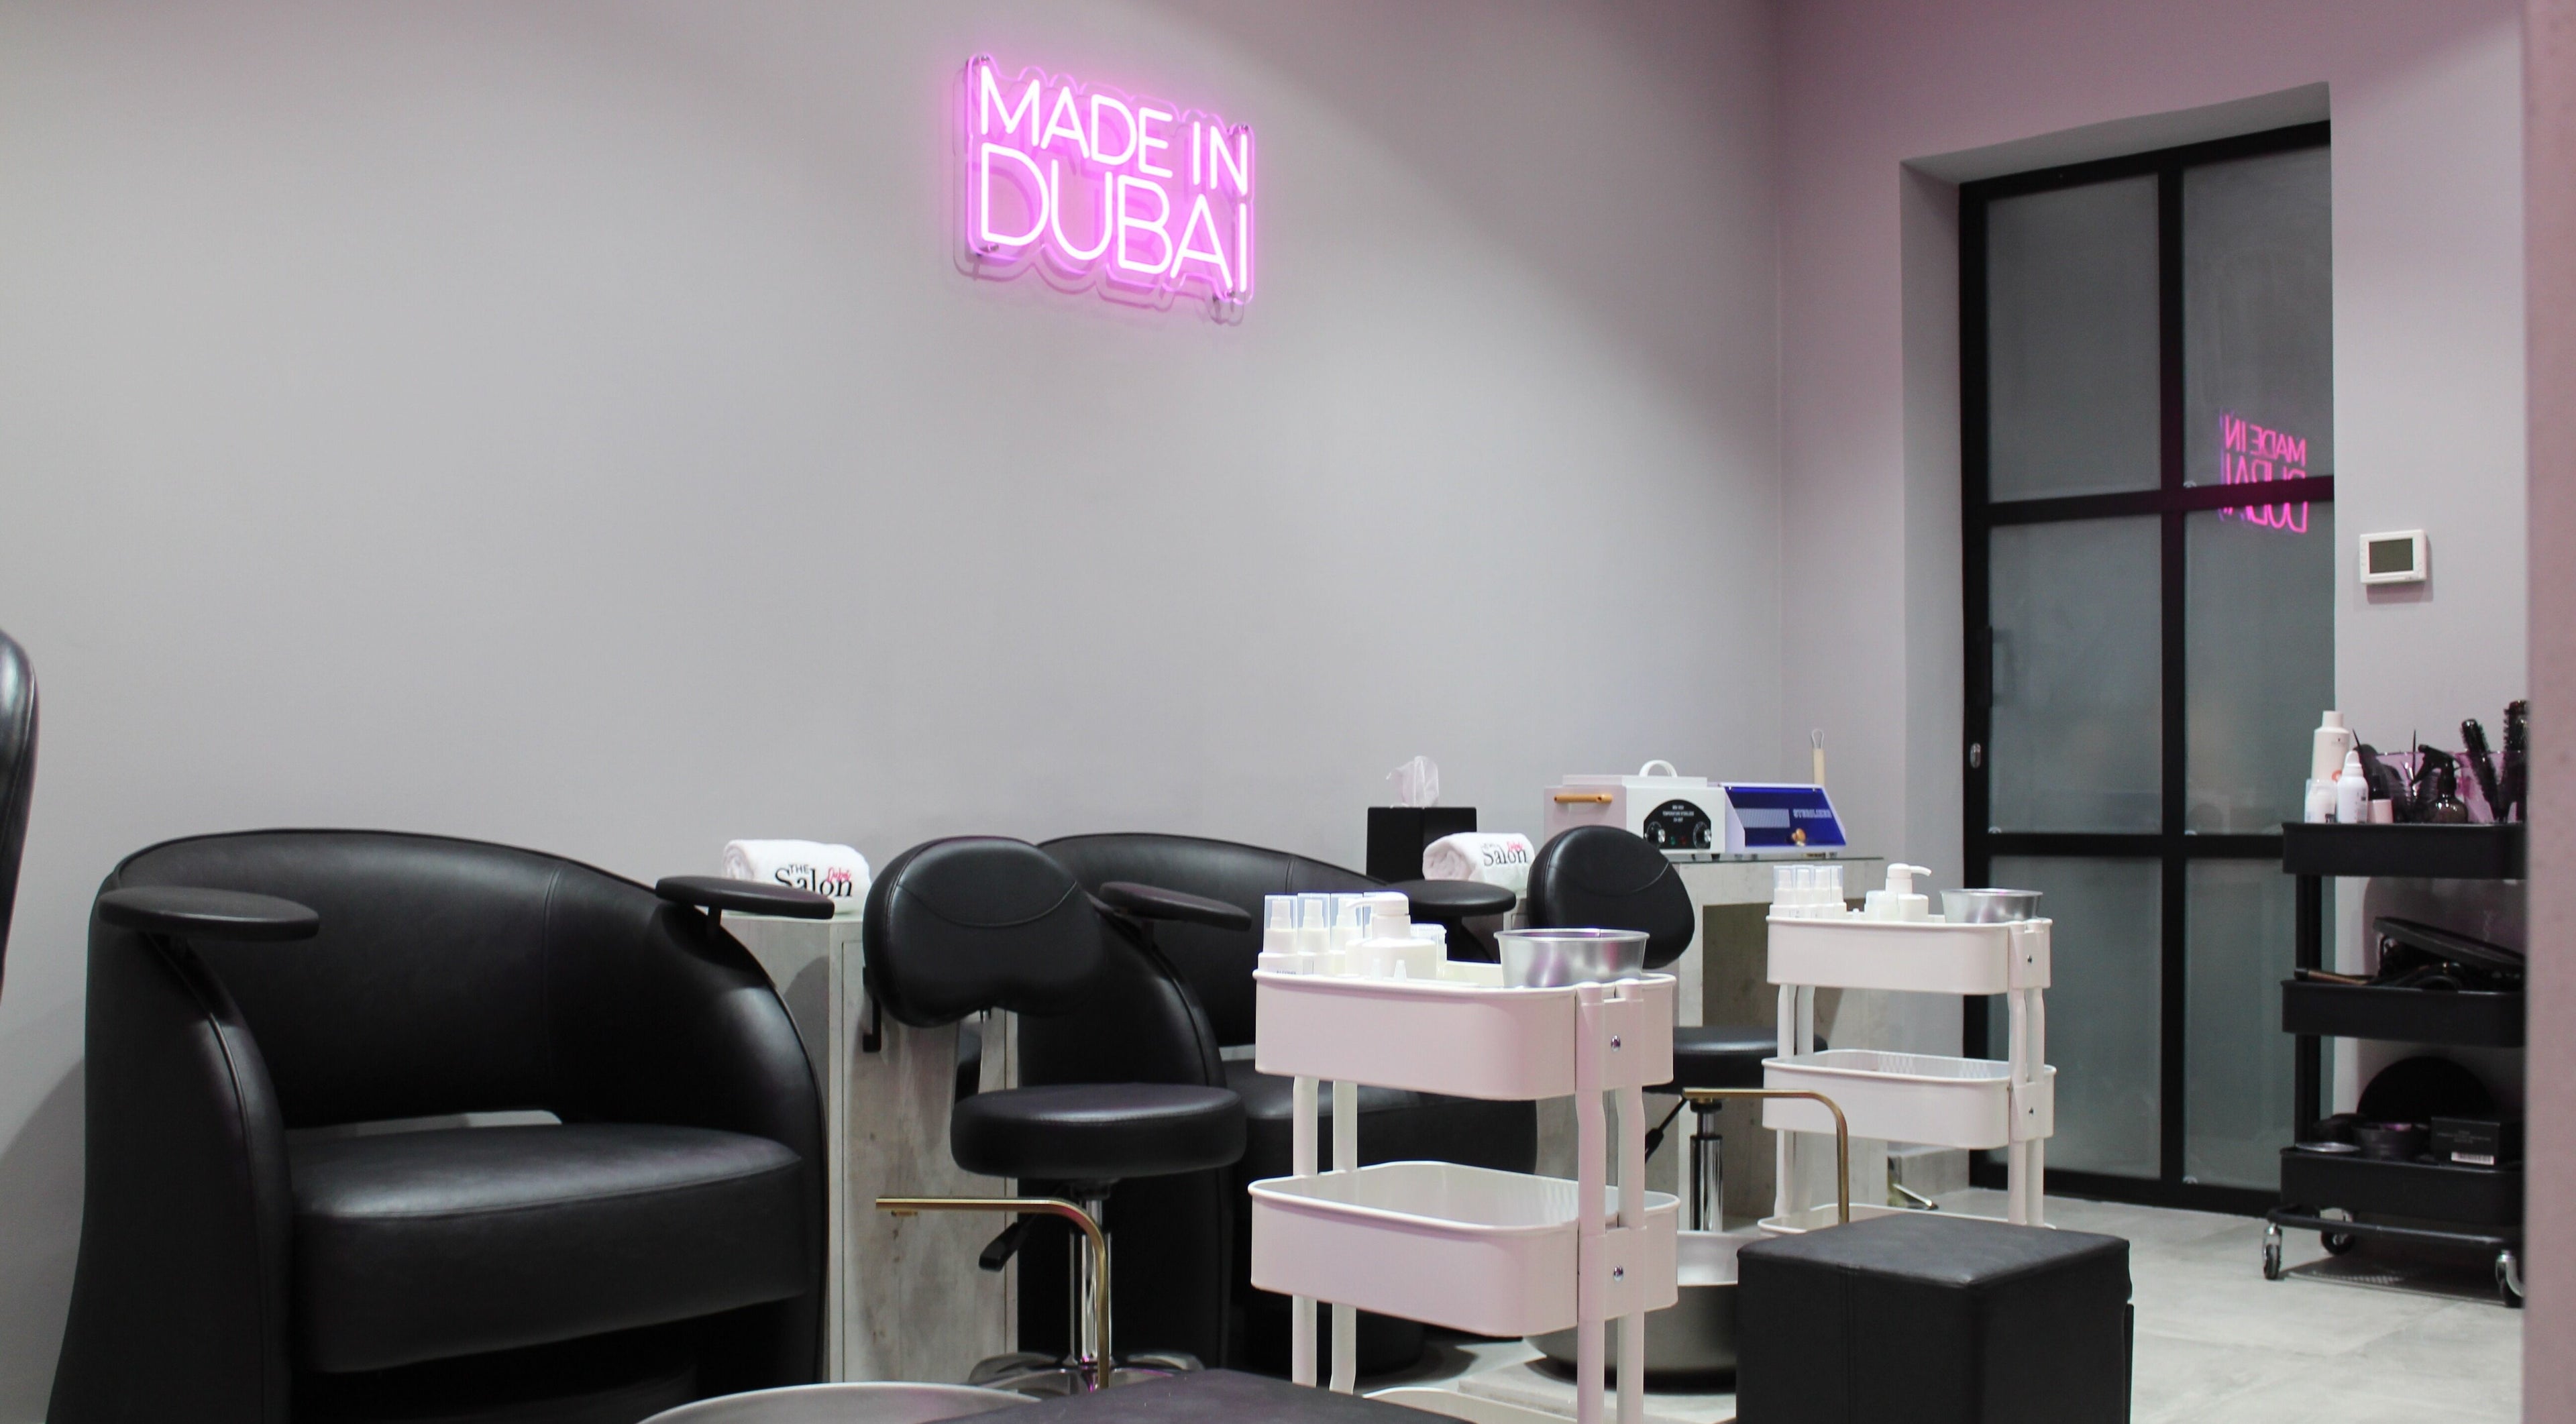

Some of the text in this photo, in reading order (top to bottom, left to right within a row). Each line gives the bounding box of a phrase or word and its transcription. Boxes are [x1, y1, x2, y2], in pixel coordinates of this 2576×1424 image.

[981, 64, 1248, 197] MADE IN
[981, 142, 1247, 292] DUBAI
[789, 863, 809, 874] THE
[1482, 844, 1527, 867] Salon
[775, 867, 852, 897] Salon
